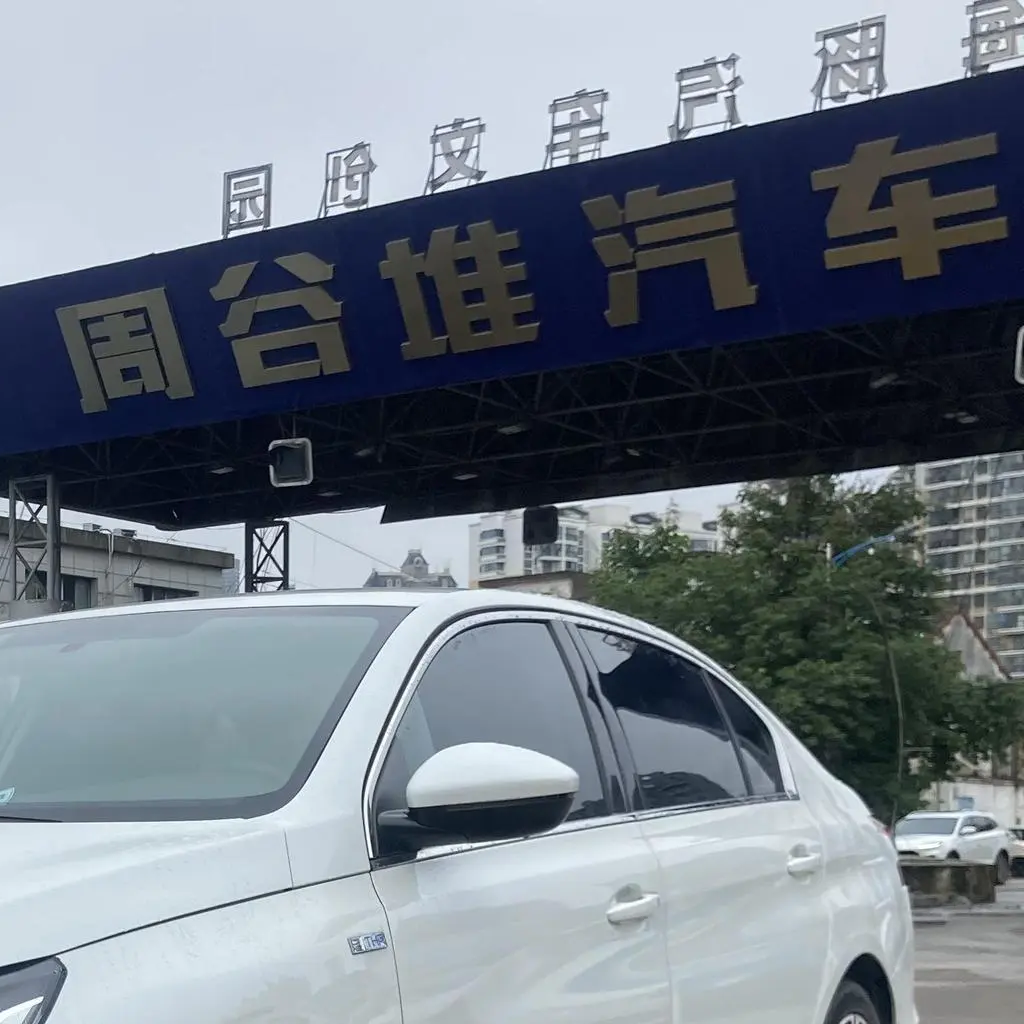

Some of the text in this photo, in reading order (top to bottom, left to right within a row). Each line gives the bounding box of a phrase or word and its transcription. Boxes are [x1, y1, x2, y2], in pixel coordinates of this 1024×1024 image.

[55, 132, 1009, 413] 周谷堆汽车
